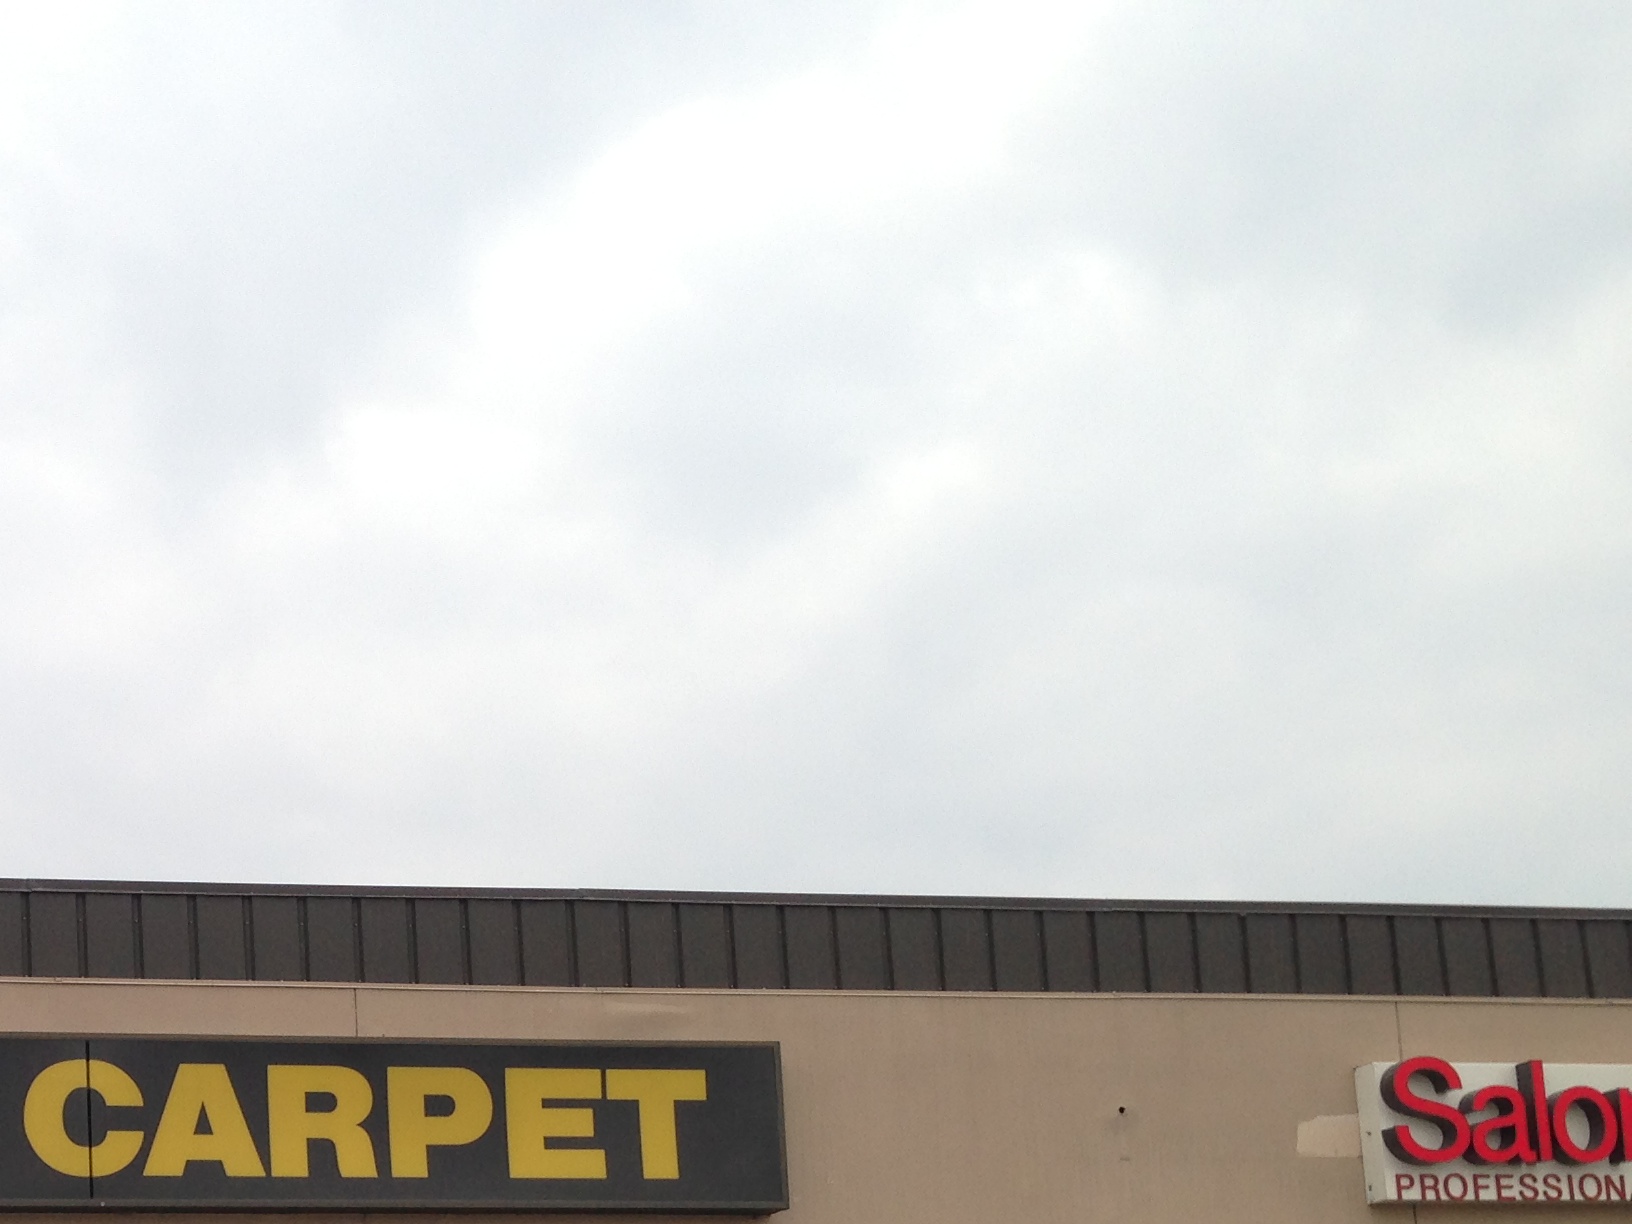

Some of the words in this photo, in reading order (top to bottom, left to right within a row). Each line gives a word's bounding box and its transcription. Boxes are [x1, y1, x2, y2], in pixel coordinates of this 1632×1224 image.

[23, 1058, 707, 1180] CARPET
[1381, 1056, 1632, 1164] Salo
[1395, 1173, 1632, 1201] PROFESSION
